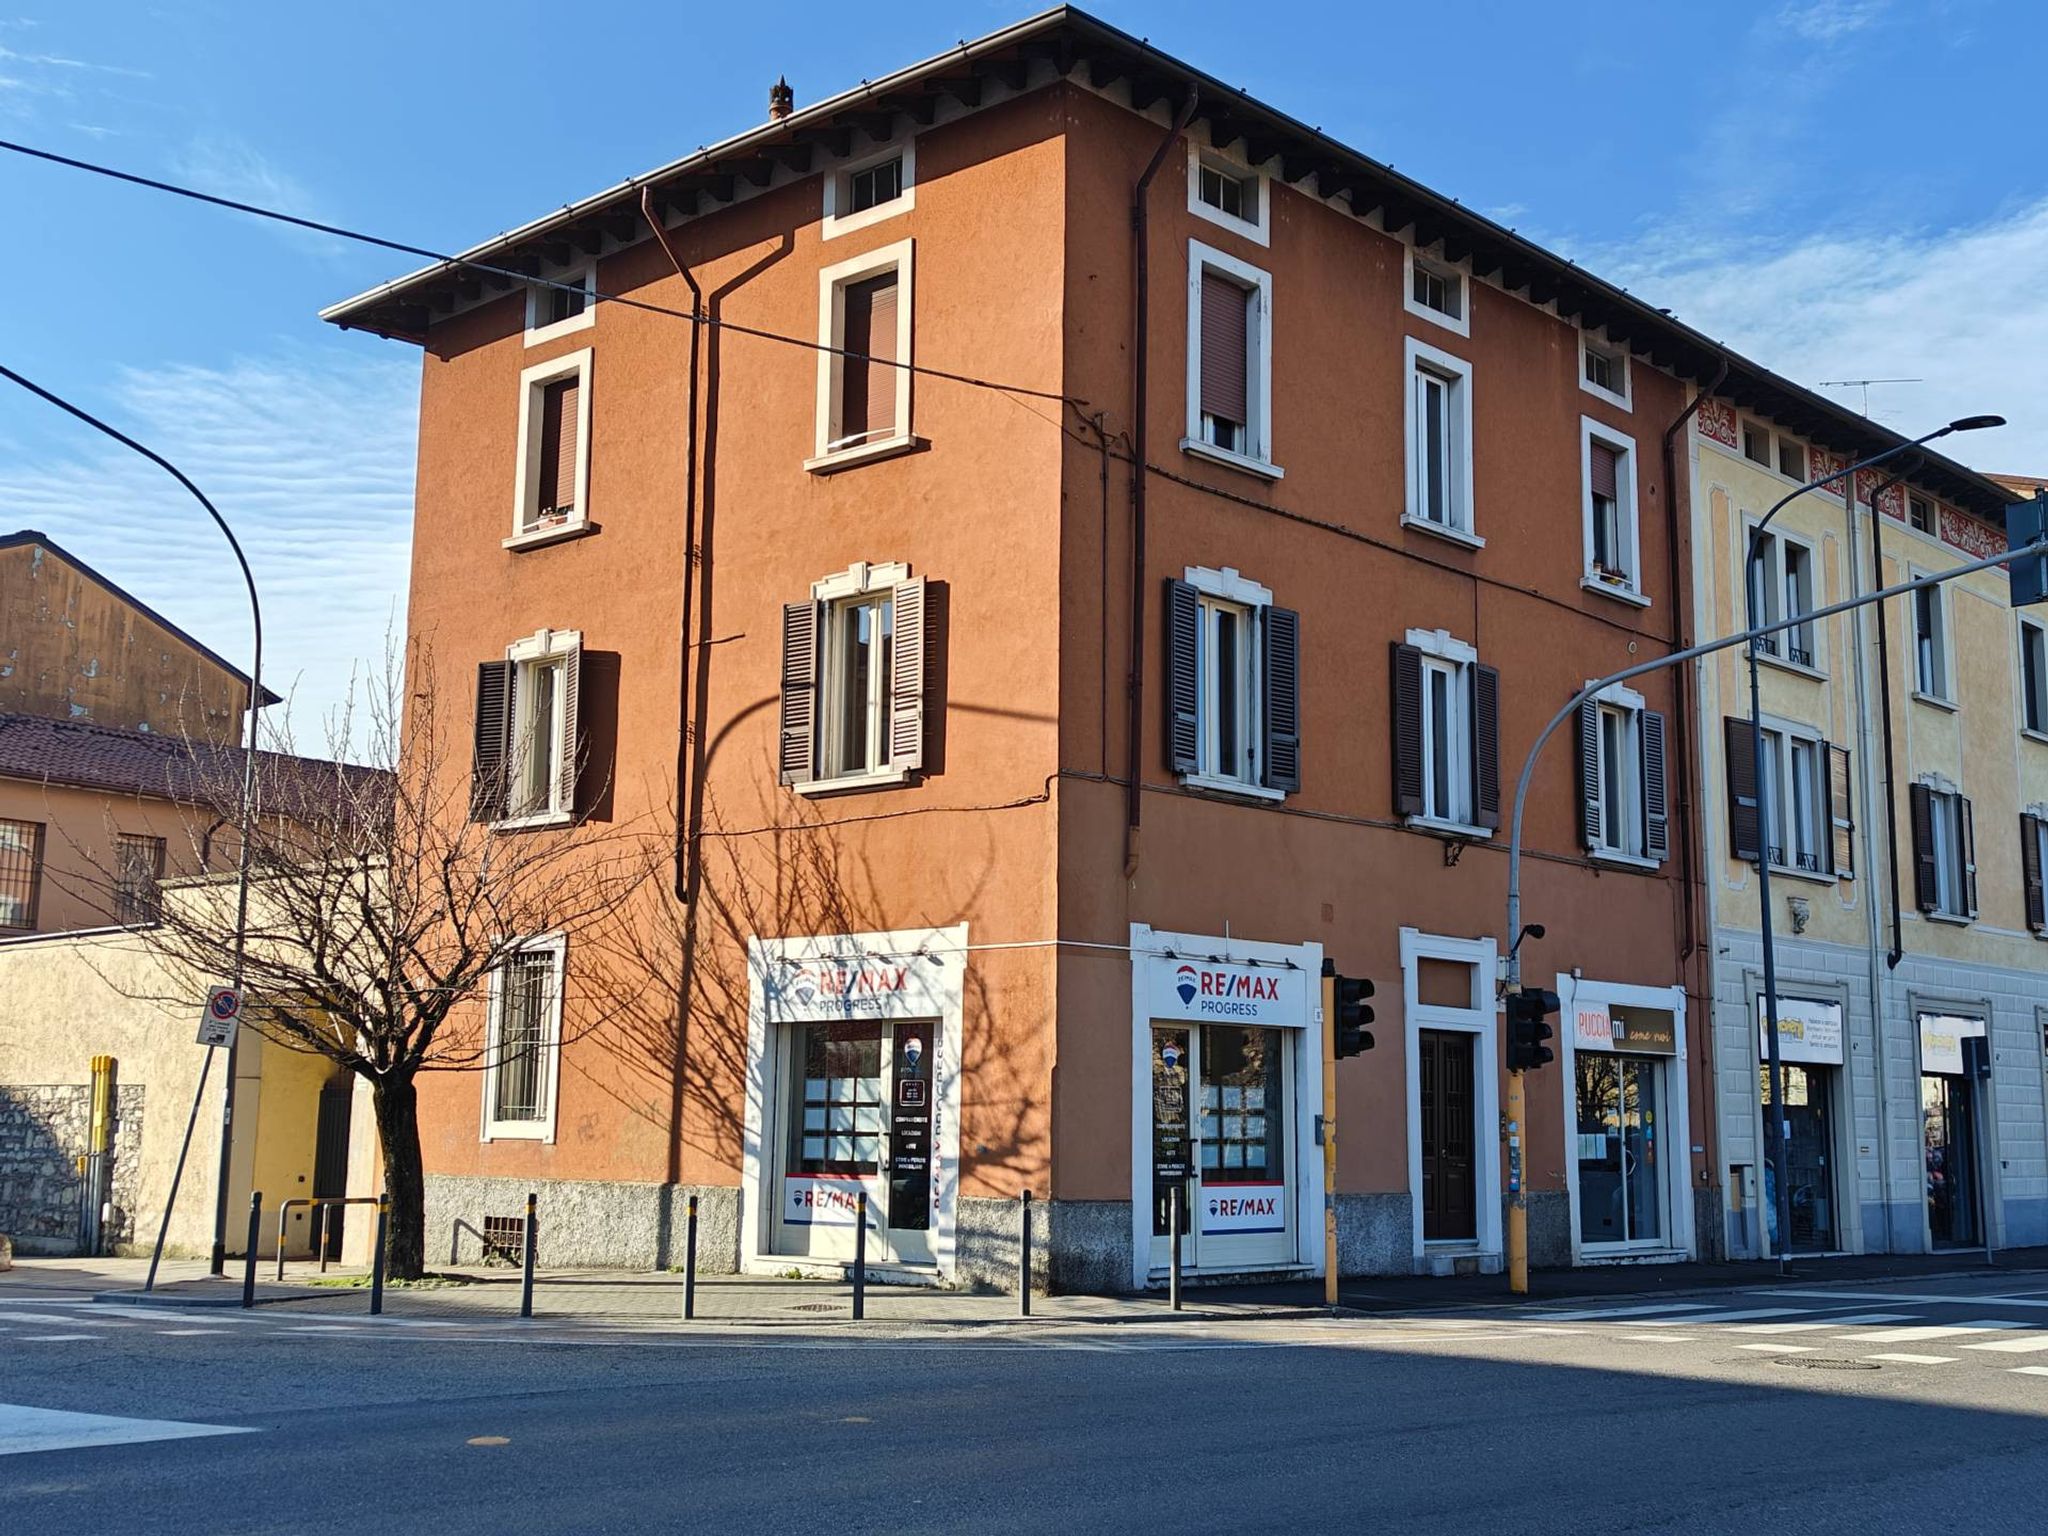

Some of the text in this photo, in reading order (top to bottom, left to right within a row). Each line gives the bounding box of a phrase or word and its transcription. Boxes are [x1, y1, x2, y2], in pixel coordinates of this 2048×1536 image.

[820, 967, 908, 996] RE/MAX
[1201, 970, 1279, 1001] RE/MAX
[819, 997, 883, 1012] PROGRESS
[1200, 1000, 1258, 1017] PROGRESS
[804, 1190, 861, 1209] RE/MA
[1220, 1198, 1275, 1217] RE/MAX
